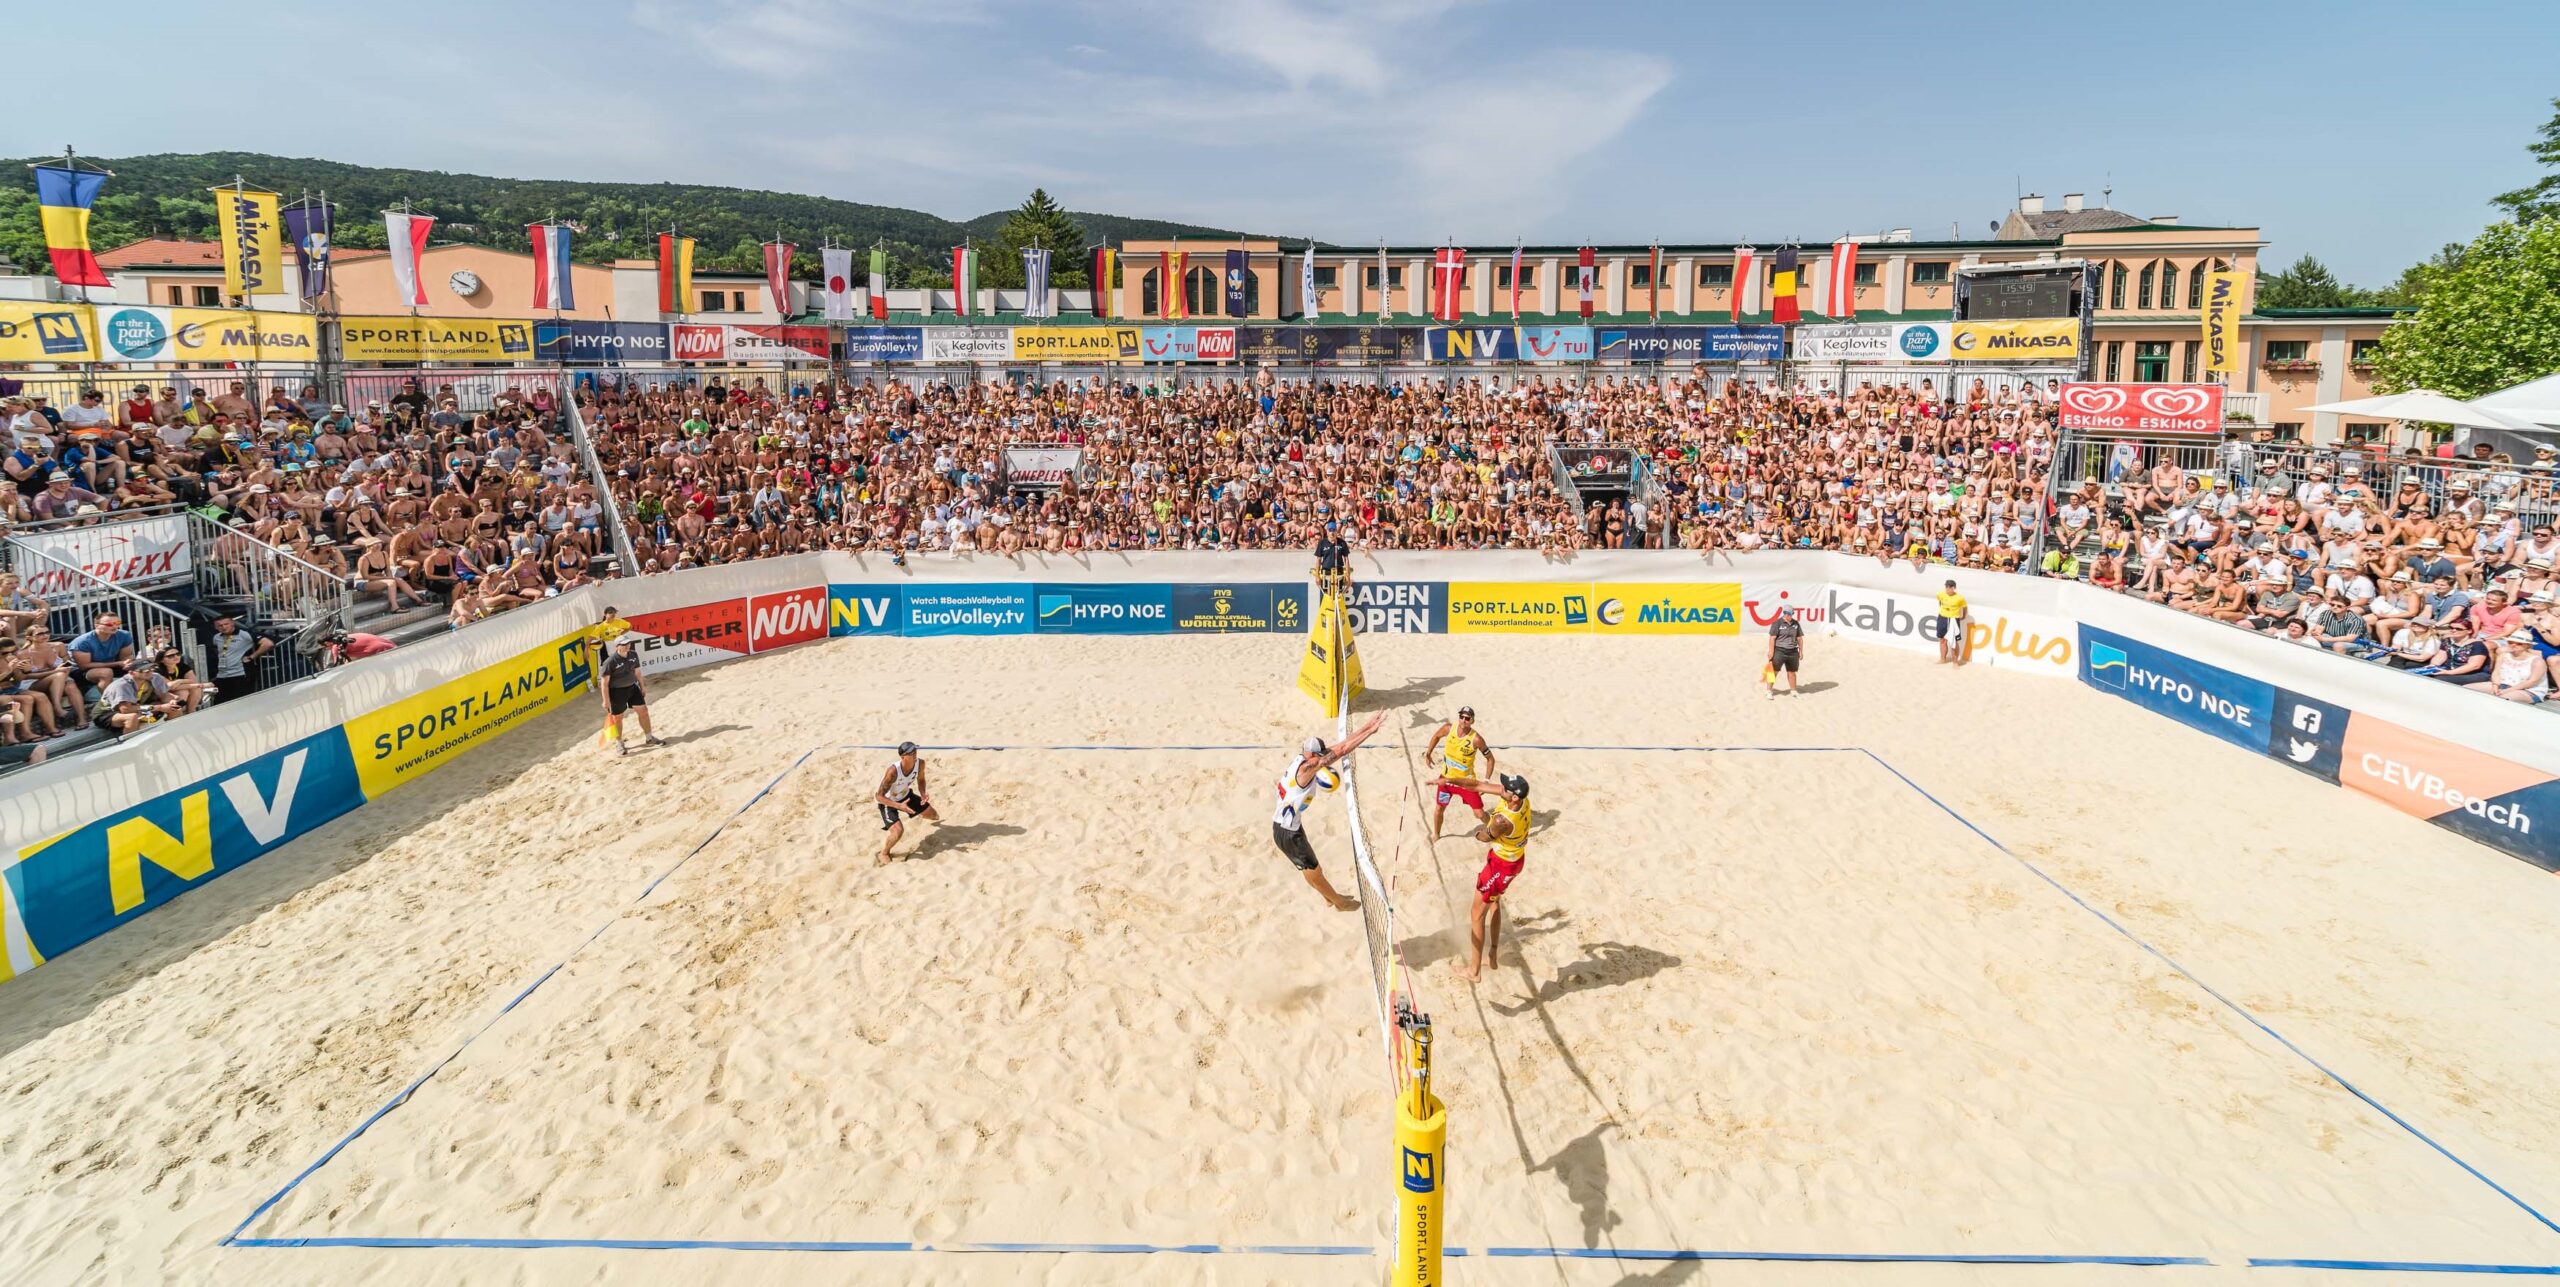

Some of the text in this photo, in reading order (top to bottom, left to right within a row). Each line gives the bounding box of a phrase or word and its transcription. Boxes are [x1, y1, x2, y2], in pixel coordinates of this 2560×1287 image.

[234, 197, 262, 290] MIKASA
[39, 316, 78, 339] N
[128, 319, 143, 327] the
[2210, 278, 2232, 366] MIKASA
[117, 321, 155, 344] park
[221, 327, 310, 347] MIKASA
[345, 329, 494, 343] SPORT.LAND.
[501, 327, 523, 344] N
[677, 328, 721, 353] NÖN
[1121, 332, 1137, 347] N
[1801, 328, 1888, 339] AUTOHAUS
[1906, 332, 1932, 348] park
[575, 335, 665, 348] HYPO NOE
[735, 336, 823, 348] STEURER
[853, 341, 918, 354] EuroVolley.tv
[952, 339, 1006, 353] Keglovits
[1016, 336, 1114, 349] SPORT.LAND.
[1175, 343, 1194, 353] TUI
[1199, 332, 1233, 353] NÖN
[1447, 329, 1502, 358] NV
[1564, 342, 1588, 354] TUI
[1628, 338, 1702, 351] HYPO NOE
[1713, 341, 1779, 353] EuroVolley.tv
[1823, 338, 1887, 351] Keglovits
[1987, 333, 2073, 349] MIKASA
[2064, 414, 2125, 427] ESKIMO
[2140, 417, 2207, 430] ESKIMO
[1009, 469, 1069, 483] CINEPLEX
[910, 596, 939, 605] Watch
[940, 595, 1012, 606] #BeachVolleyball
[1343, 584, 1430, 606] BADEN
[830, 597, 891, 628] NV
[1074, 604, 1166, 619] HYPO NOE
[1452, 601, 1560, 614] SPORT.LAND.
[1567, 599, 1585, 615] N
[1637, 601, 1735, 623] MIKASA
[1794, 607, 1825, 622] TUI
[753, 594, 826, 641] NÖN
[912, 608, 1025, 628] EuroVolley.tv
[1180, 619, 1266, 628] WORLD TOUR
[1277, 619, 1298, 627] CEV
[1347, 607, 1430, 634] OPEN
[1467, 618, 1553, 627] www.sportlandnoe.at
[628, 620, 743, 652] TEURER
[2129, 665, 2252, 728] HYPO NOE
[375, 666, 554, 760] SPORT.LAND.
[395, 695, 549, 774] www.facebook.com/sportlandnoe
[1465, 739, 1471, 748] 2
[2361, 753, 2530, 834] CEVBeach
[106, 747, 309, 916] NV
[1406, 1153, 1430, 1179] N
[1417, 1205, 1427, 1284] SPORT.LAND.
